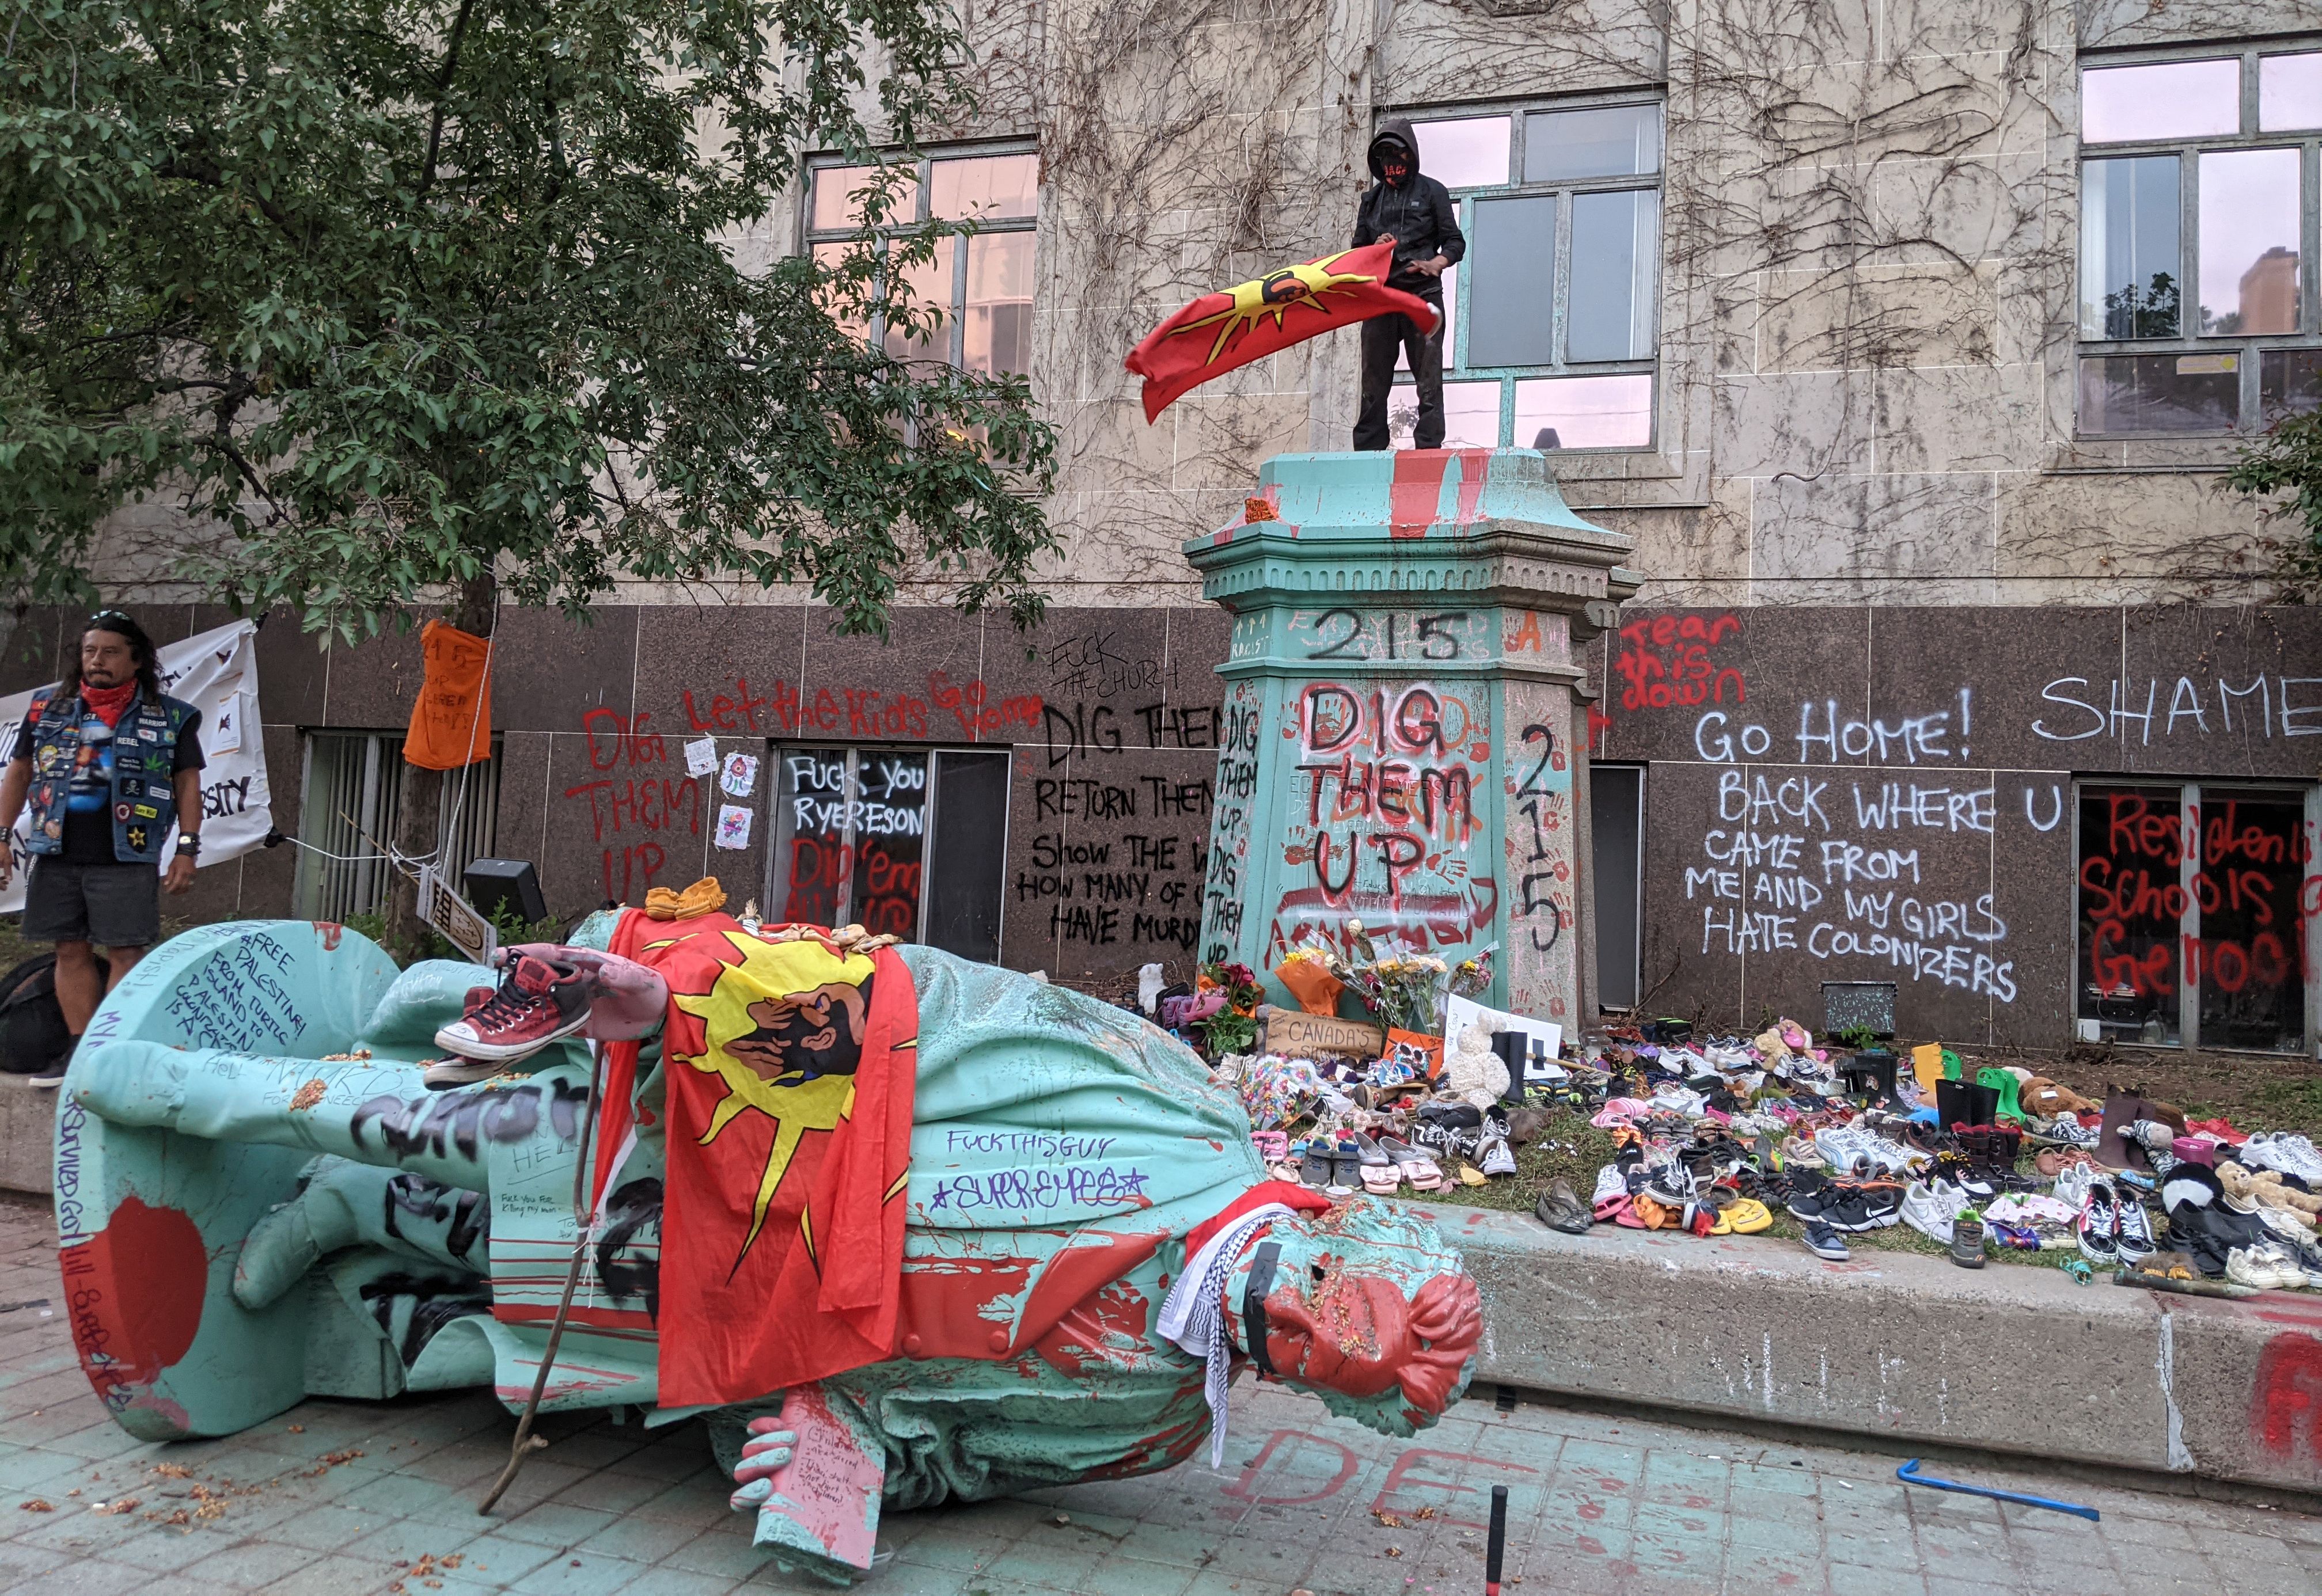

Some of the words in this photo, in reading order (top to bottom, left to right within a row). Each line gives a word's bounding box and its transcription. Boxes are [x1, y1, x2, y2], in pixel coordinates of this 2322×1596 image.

[1306, 607, 1467, 660] 215
[1052, 668, 1096, 698] THE
[1097, 657, 1179, 698] CHURCH
[1615, 643, 1713, 681] this
[771, 679, 842, 731] the
[1622, 667, 1745, 711] down
[2031, 671, 2322, 747] SHAME
[117, 736, 139, 747] REBEL
[139, 717, 168, 727] WARRIOR
[582, 707, 667, 771] DIG
[1042, 702, 1124, 770] DIG
[1226, 704, 1261, 759] DIG
[1306, 687, 1445, 755] DIG
[1218, 757, 1259, 800] THEM
[1293, 757, 1474, 835] THEM
[1720, 770, 1830, 832] BACK
[1852, 782, 1997, 833] WHERE
[2025, 785, 2063, 832] U
[564, 778, 699, 842] THEM
[1122, 835, 1179, 871] THE
[1312, 827, 1425, 896] UP
[1705, 830, 1804, 870] CAME
[1820, 840, 1921, 885] FROM
[1085, 873, 1150, 907] MANY
[1159, 881, 1187, 911] OF
[1685, 866, 1740, 899] ME
[1754, 872, 1823, 913] AND
[1843, 888, 1895, 930] MY
[1900, 893, 2008, 941] GIRLS
[1049, 905, 1119, 945] HAVE
[1132, 912, 1200, 952] MURD
[1702, 906, 1797, 955] HATE
[1808, 922, 2017, 1003] COLONIZERS
[210, 951, 245, 998] FROM
[1288, 1020, 1370, 1048] CANADA'S
